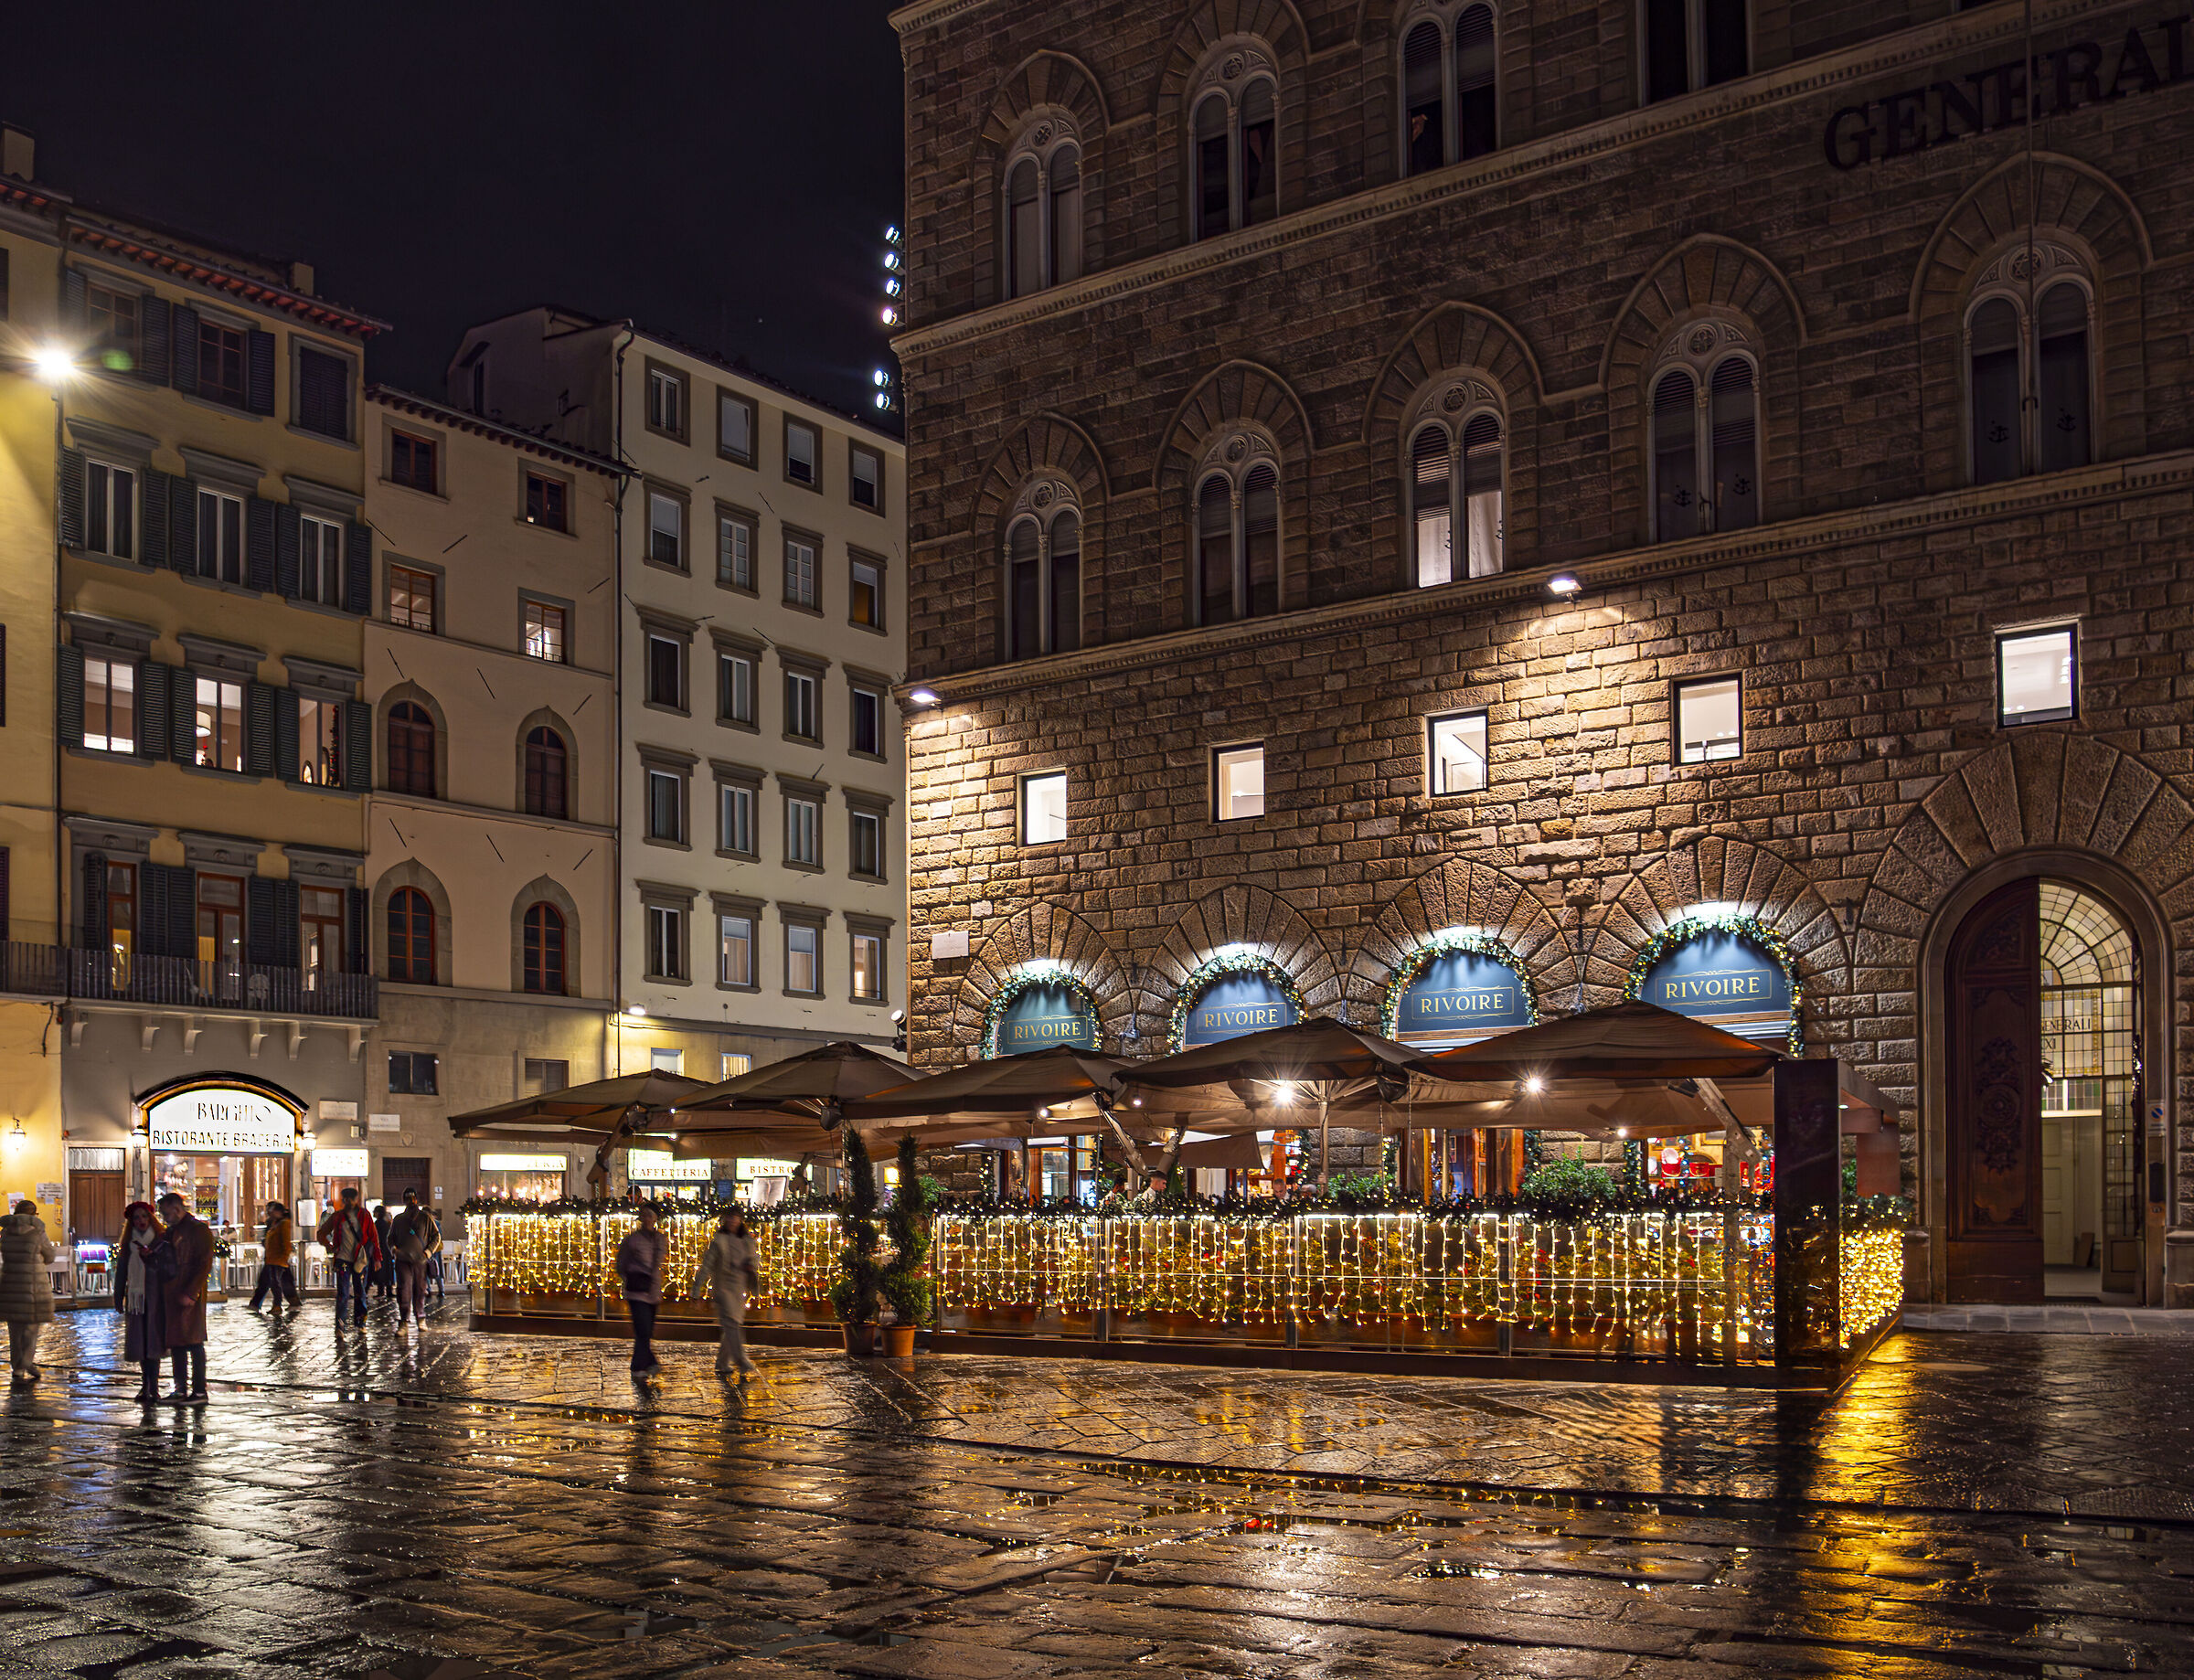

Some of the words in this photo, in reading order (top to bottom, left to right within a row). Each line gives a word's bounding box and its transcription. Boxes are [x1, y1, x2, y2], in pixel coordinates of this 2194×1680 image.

[1666, 976, 1760, 999] RIVOIRE
[1421, 993, 1504, 1014] RIVOIRE
[1205, 1008, 1278, 1027] RIVOIRE
[1015, 1020, 1081, 1039] RIVOIRE
[153, 1130, 229, 1146] RISTORANTE
[233, 1132, 293, 1148] BRACERIA
[632, 1168, 708, 1177] CAFFETTERIA
